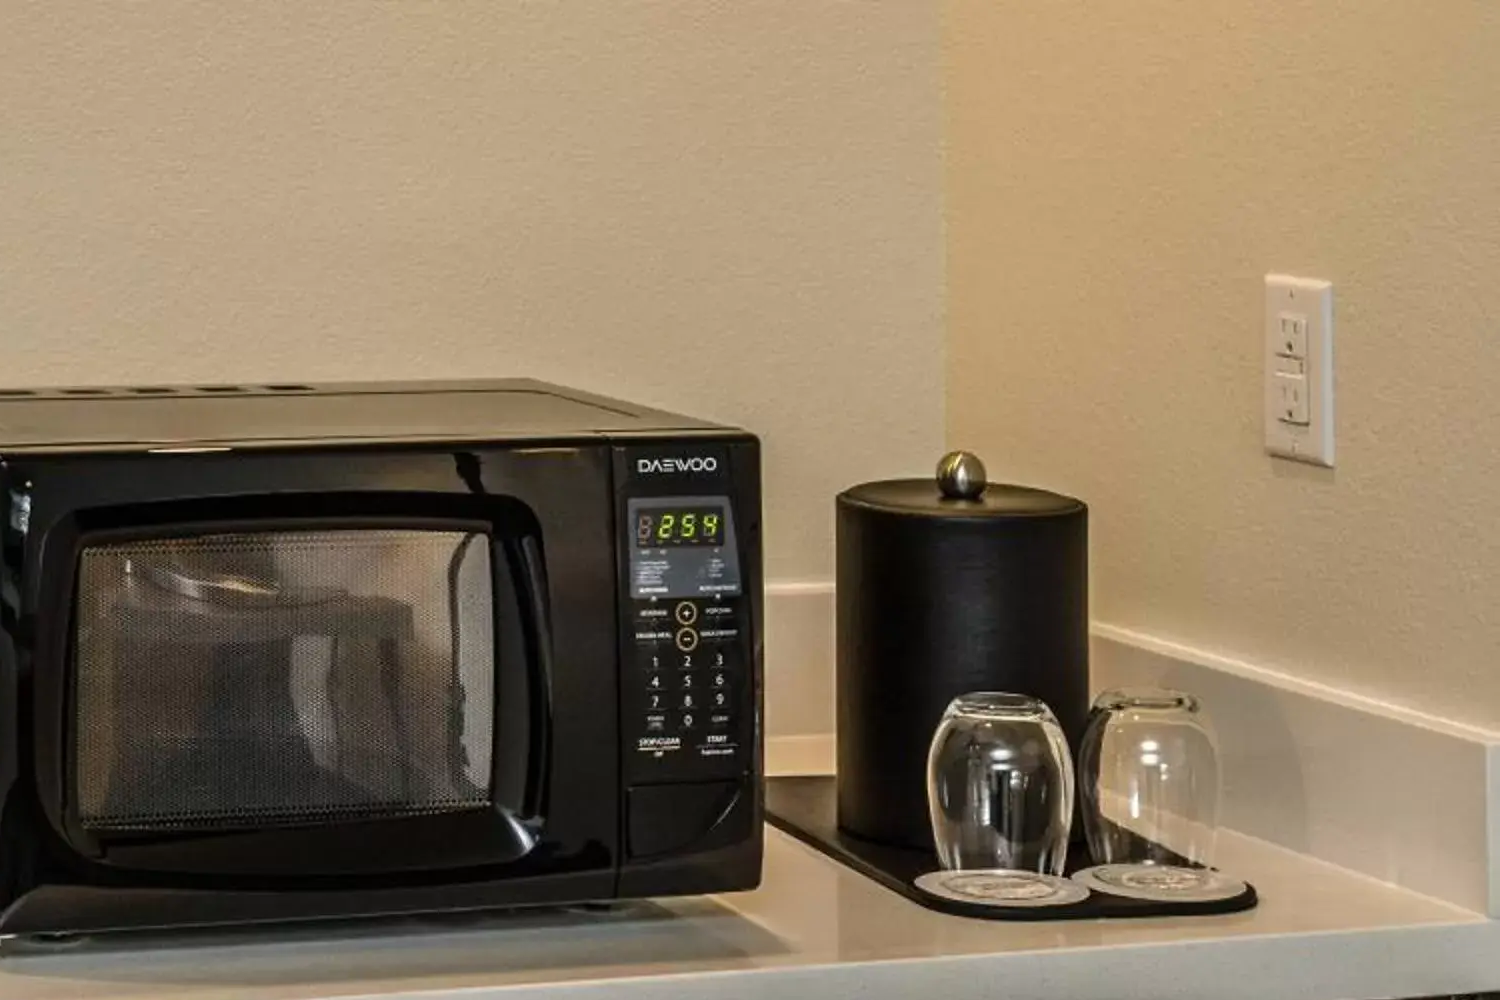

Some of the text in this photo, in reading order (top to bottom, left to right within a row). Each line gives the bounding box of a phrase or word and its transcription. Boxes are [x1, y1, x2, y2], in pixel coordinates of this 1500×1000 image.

[637, 457, 717, 473] DAEWOO
[652, 655, 659, 668] 1
[683, 655, 692, 667] 2
[715, 653, 724, 666] 3
[651, 675, 660, 687] 4
[683, 674, 692, 687] 5
[715, 673, 725, 686] 6
[651, 695, 660, 708] 7
[683, 695, 693, 707] 8
[715, 693, 725, 705] 9
[683, 714, 693, 727] 0
